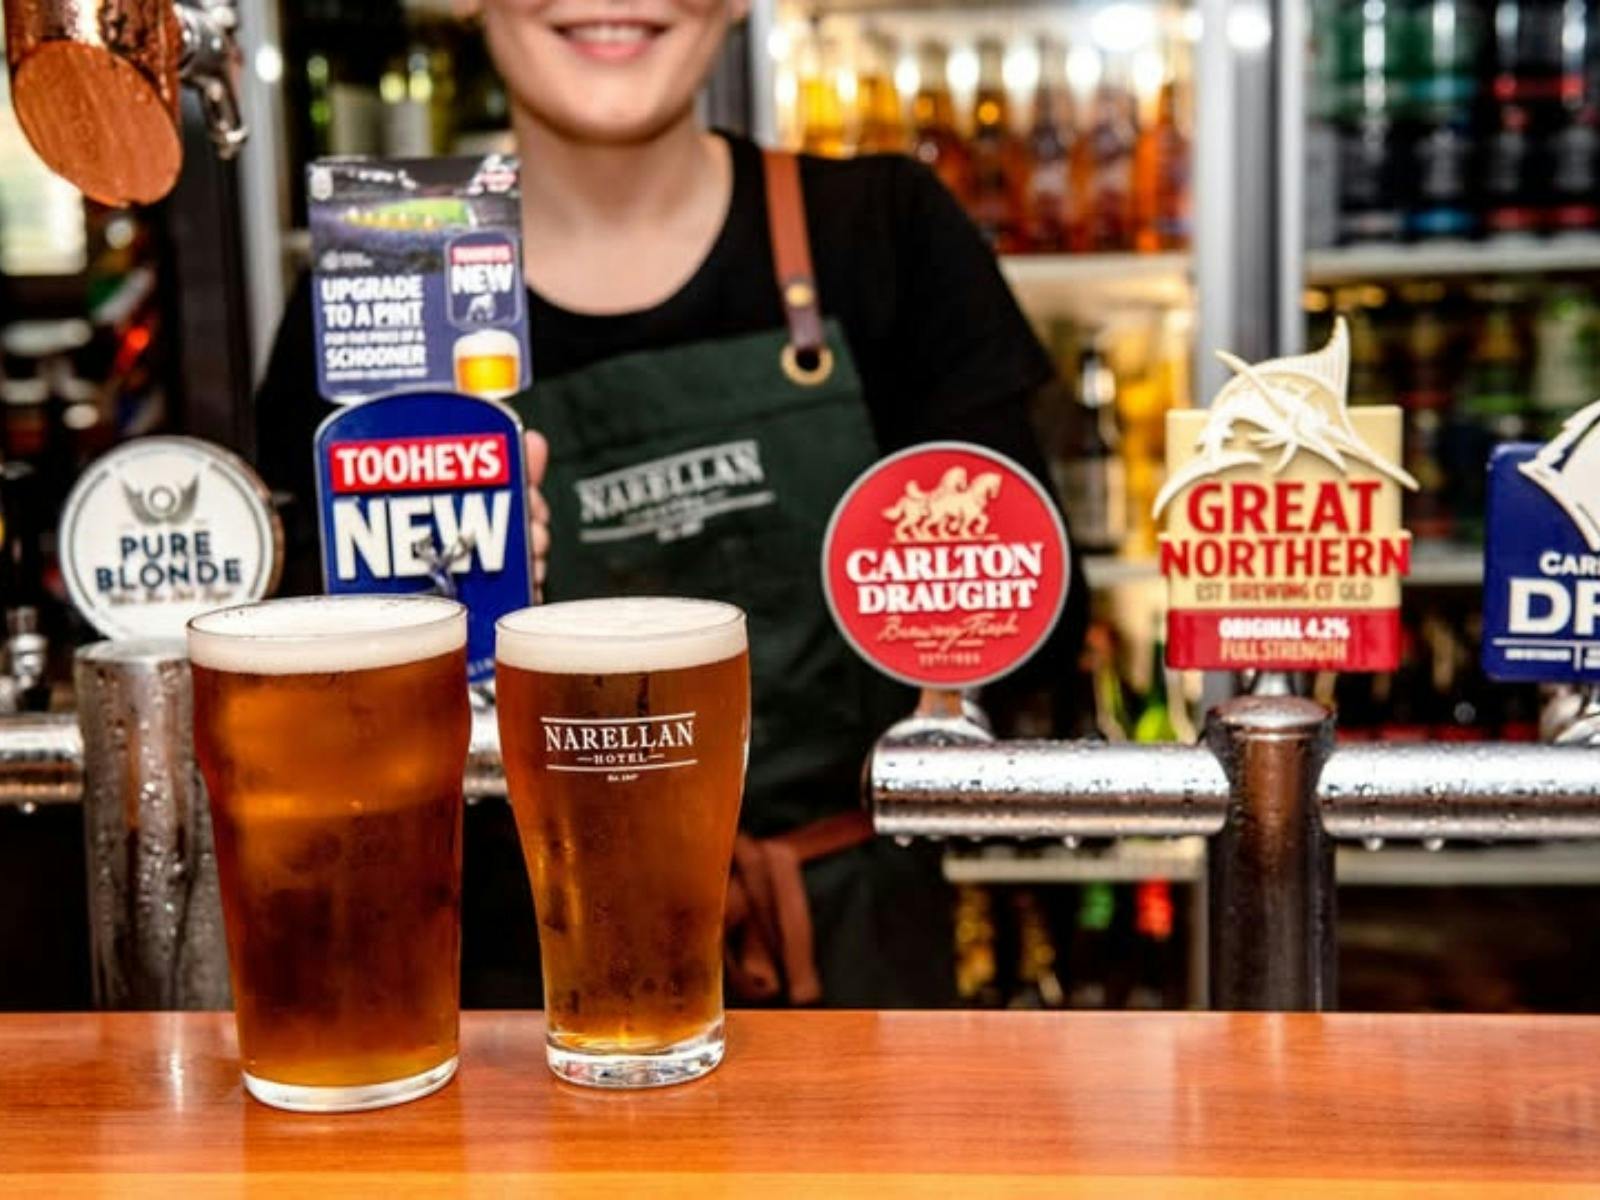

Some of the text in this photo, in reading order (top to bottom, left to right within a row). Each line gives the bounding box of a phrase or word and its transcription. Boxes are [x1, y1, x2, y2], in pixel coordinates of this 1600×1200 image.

[321, 275, 424, 301] UPGRADE
[452, 263, 514, 294] NEW
[324, 301, 424, 328] TO A PINT
[326, 345, 426, 369] SCHOONER
[336, 441, 501, 486] TOOHEYS
[576, 445, 765, 523] NARELLAN
[1187, 480, 1381, 534] GREAT
[120, 532, 211, 560] PURE
[332, 489, 511, 580] NEW
[846, 542, 1044, 583] CARLTON
[1160, 538, 1412, 577] NORTHERN
[96, 560, 243, 592] BLONDE
[857, 579, 1037, 614] DRAUGHT
[1219, 617, 1303, 639] ORIGINAL
[544, 721, 694, 752] NARELLAN
[593, 753, 647, 765] HOTEL
